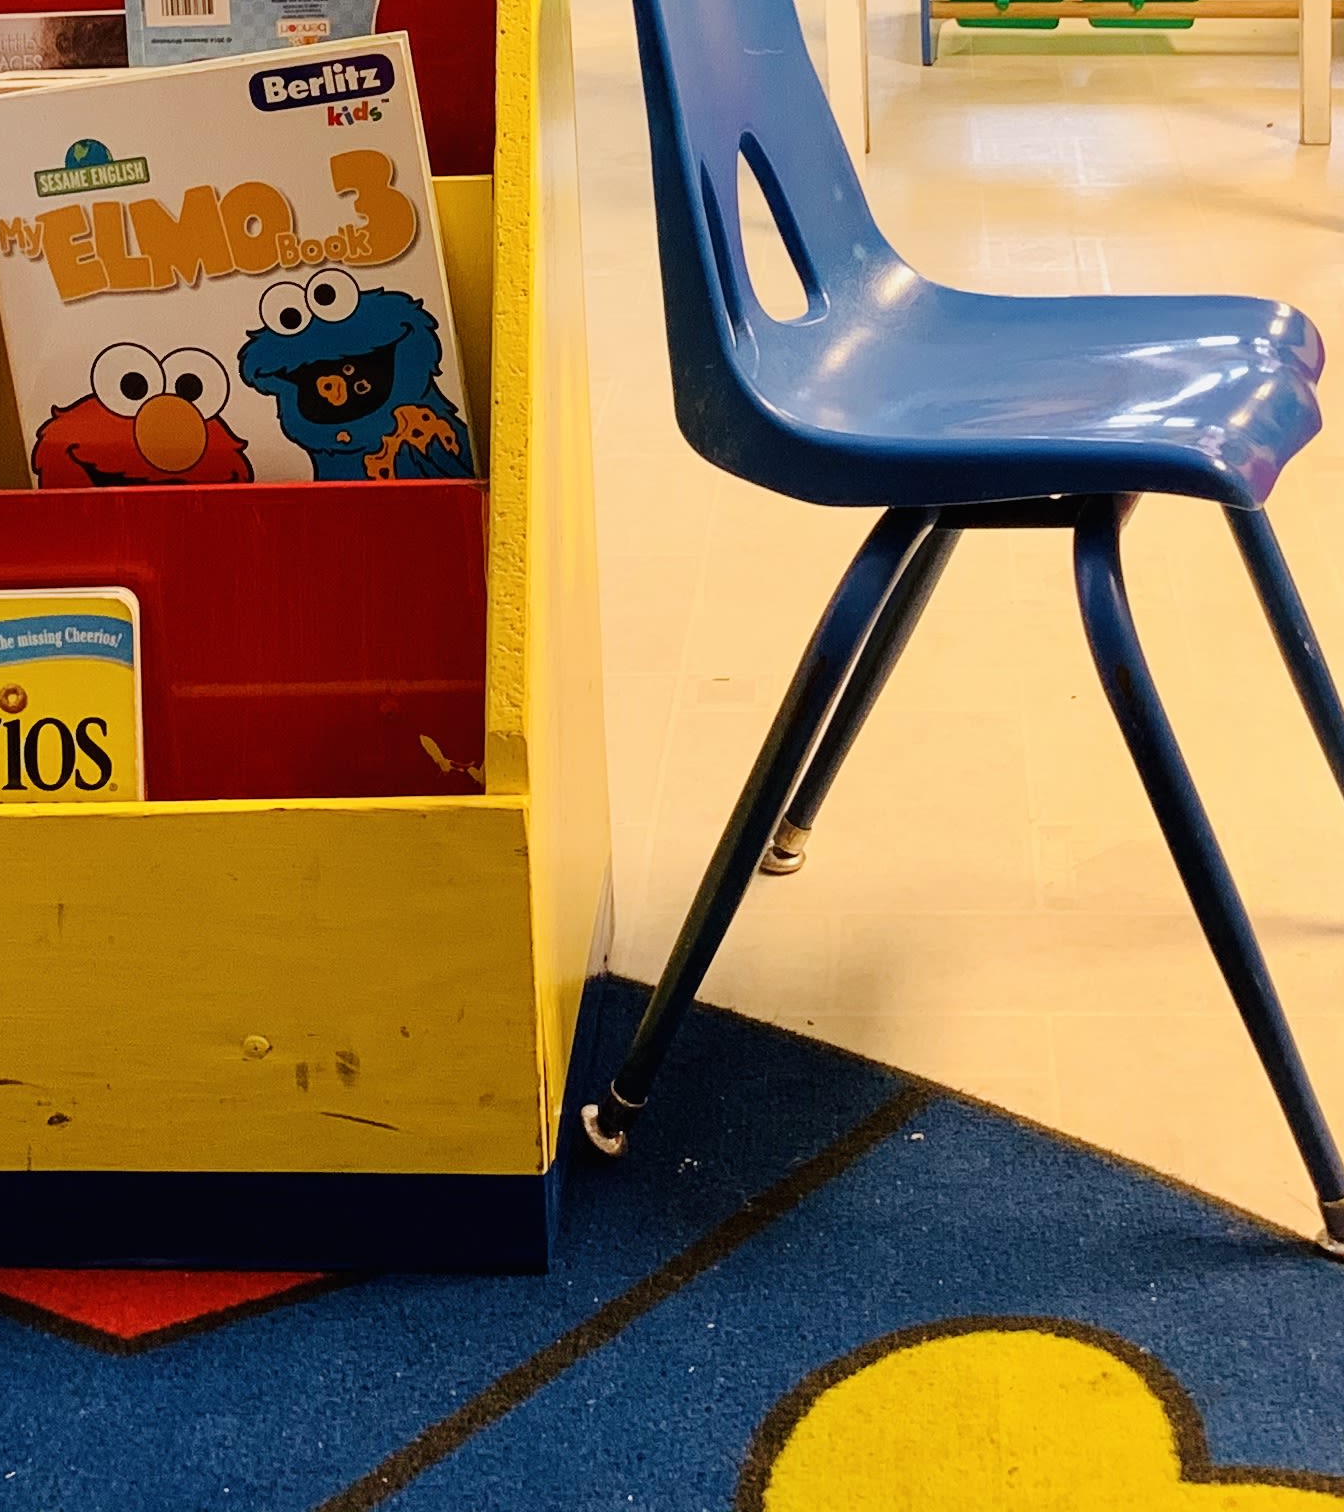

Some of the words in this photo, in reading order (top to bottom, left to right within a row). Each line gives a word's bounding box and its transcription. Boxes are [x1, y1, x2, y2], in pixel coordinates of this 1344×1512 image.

[261, 61, 382, 105] Berlitz
[326, 100, 383, 128] kids
[38, 167, 91, 194] SESAME
[91, 160, 146, 187] ENGLISH
[37, 180, 295, 303] ELMO
[329, 148, 417, 267] 3
[16, 629, 63, 652] missing
[64, 625, 123, 649] Cheerios!
